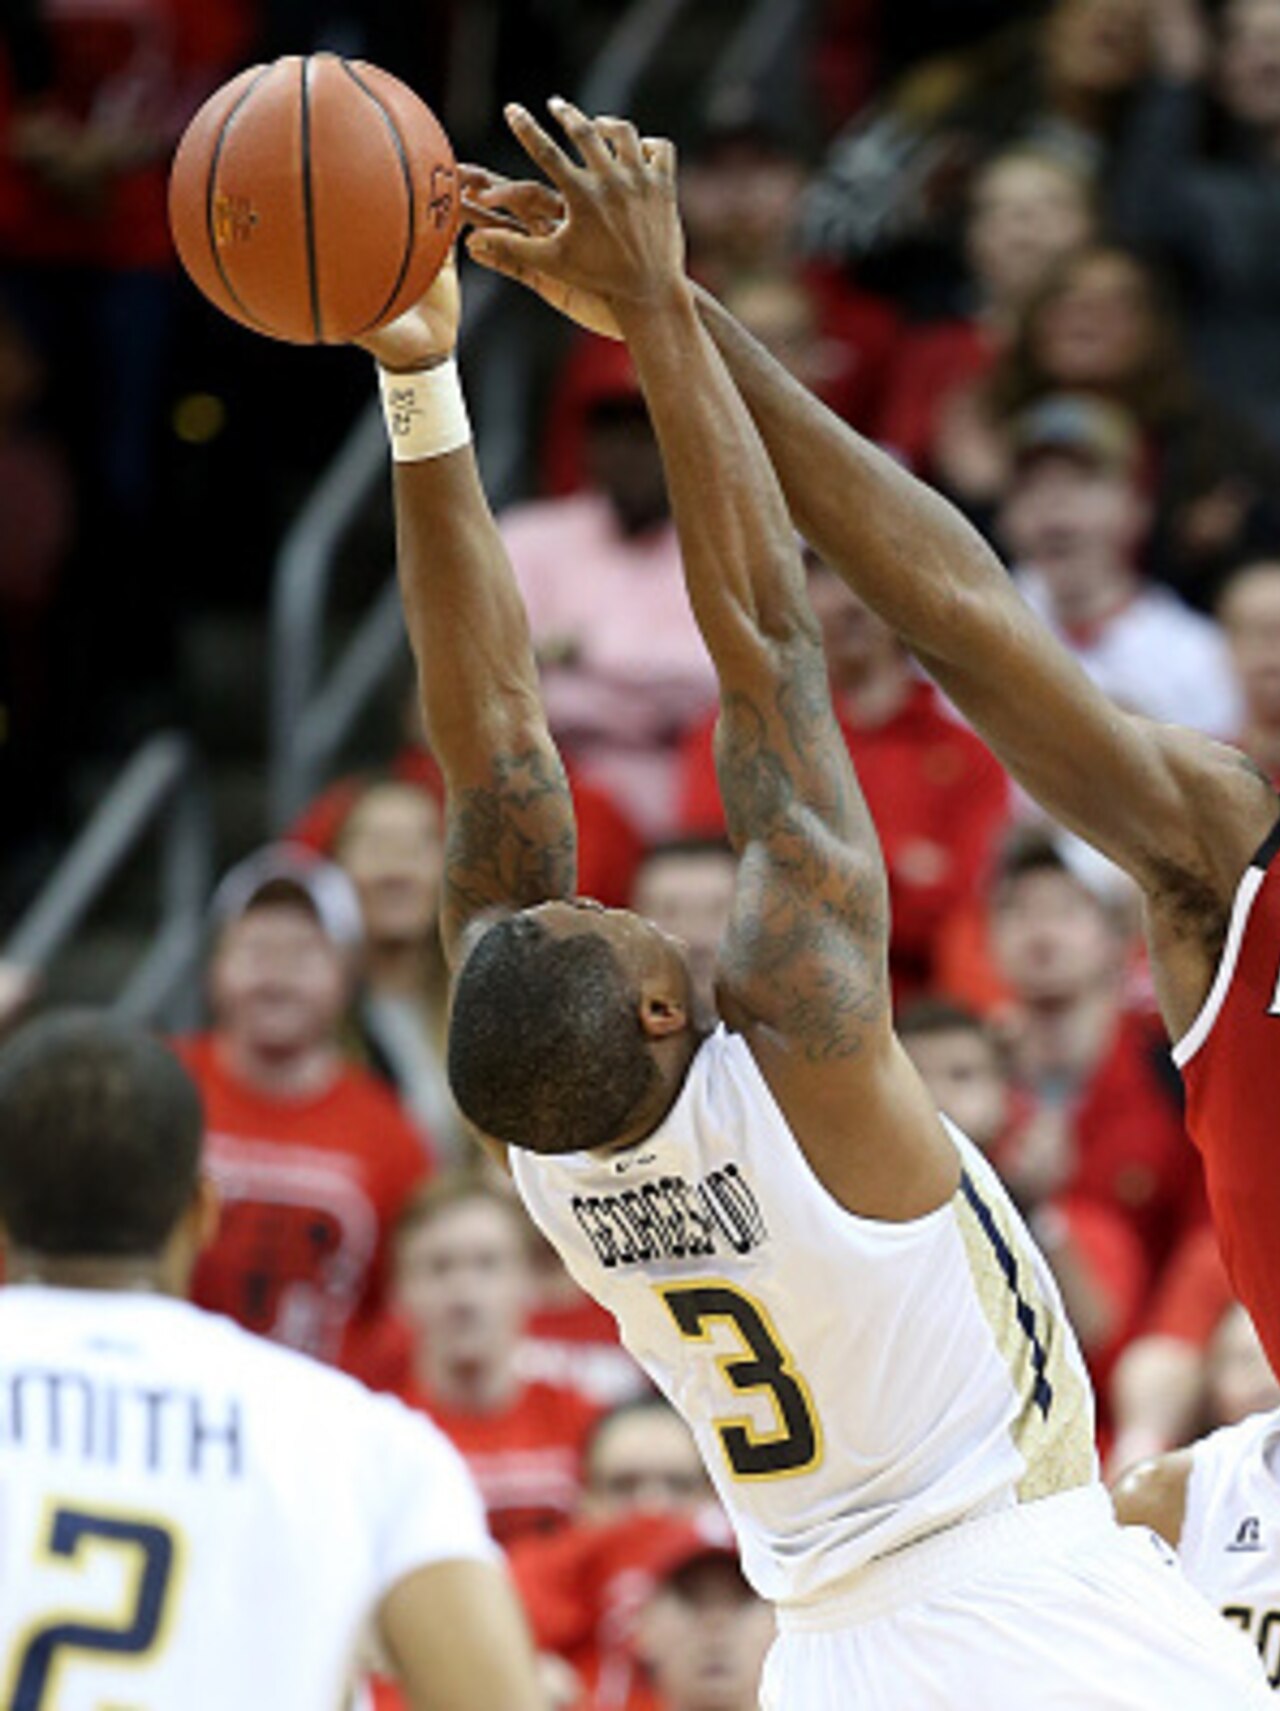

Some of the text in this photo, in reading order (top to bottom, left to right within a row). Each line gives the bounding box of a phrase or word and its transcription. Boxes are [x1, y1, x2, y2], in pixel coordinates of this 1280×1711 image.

[0, 1367, 248, 1482] MITH
[650, 1278, 823, 1484] 3
[3, 1496, 192, 1711] 2
